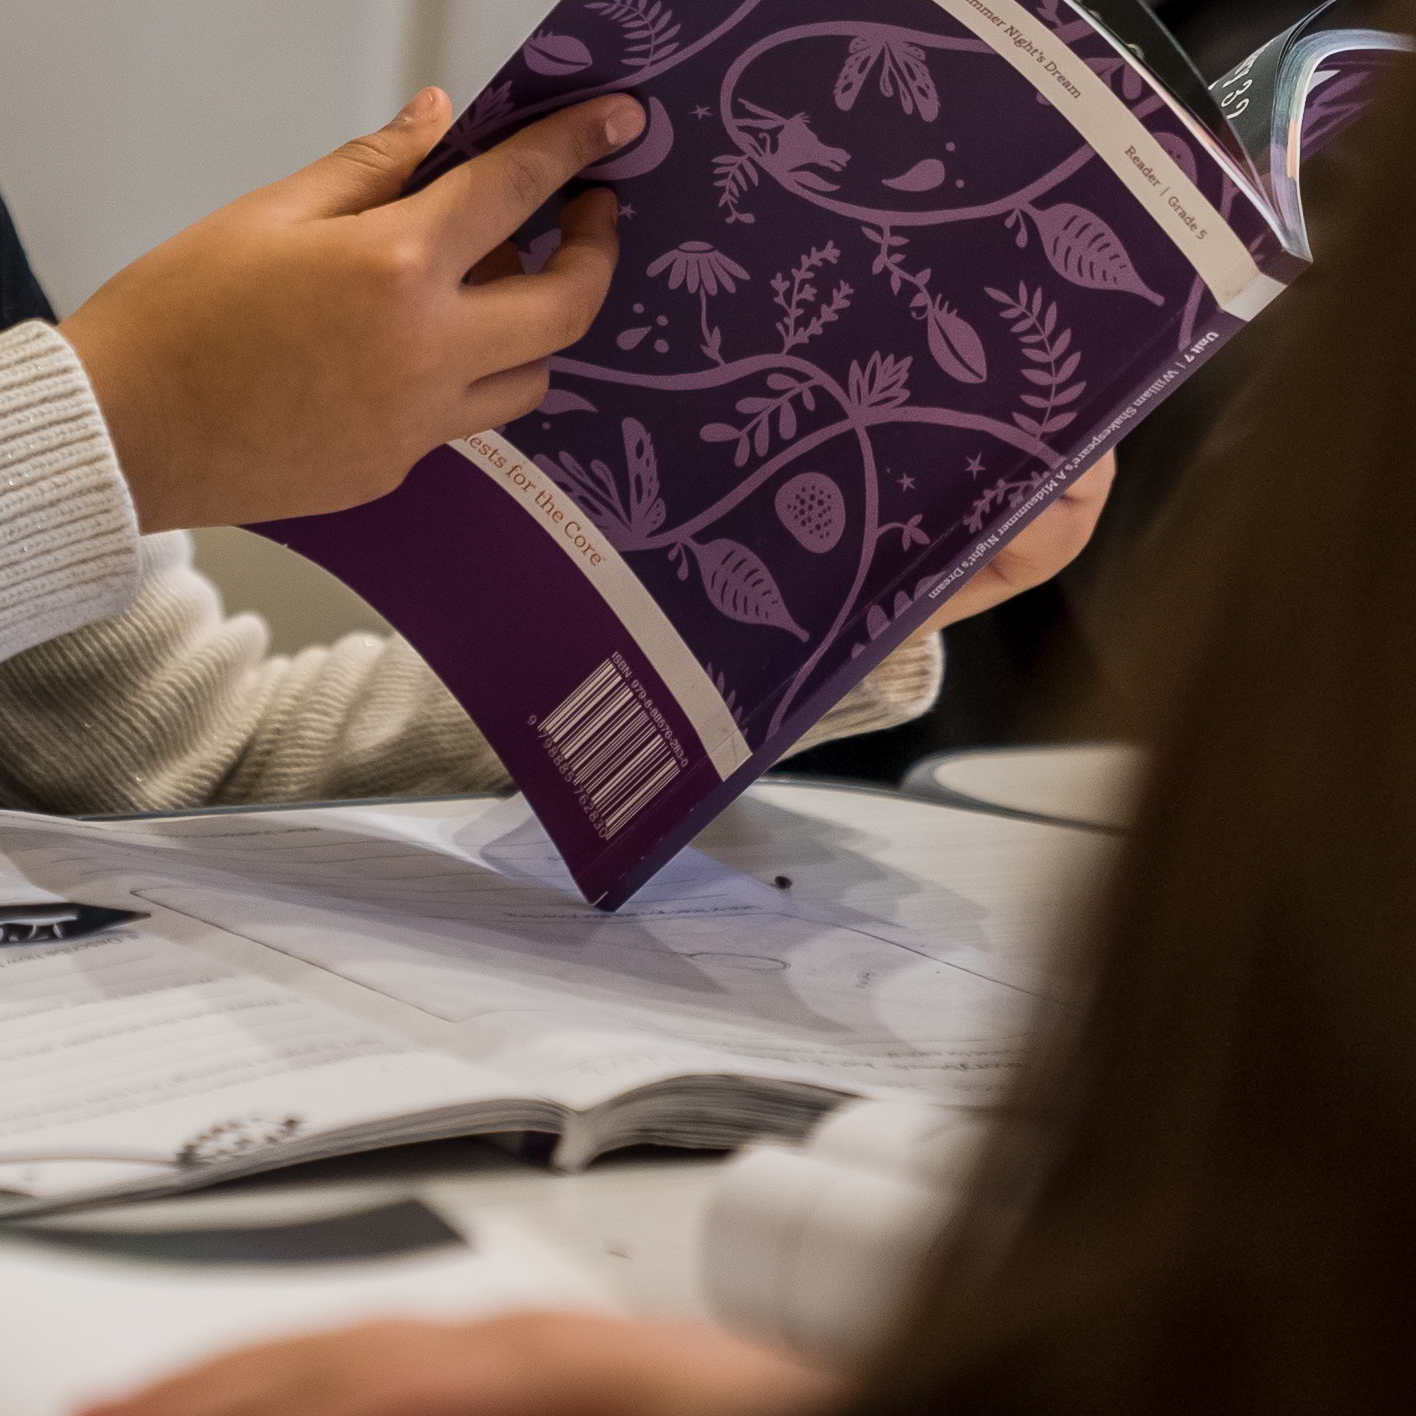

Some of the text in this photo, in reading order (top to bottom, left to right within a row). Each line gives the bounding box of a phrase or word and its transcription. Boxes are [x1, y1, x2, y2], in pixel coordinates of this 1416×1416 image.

[1003, 25, 1047, 64] Night's
[1043, 60, 1082, 100] Dream
[1124, 144, 1161, 188] Reader
[1167, 197, 1198, 233] Grade
[1196, 230, 1208, 240] 5
[1184, 353, 1195, 363] 7
[1190, 331, 1220, 356] Unit
[1132, 370, 1180, 409] William
[1064, 405, 1138, 474] Shakespeare's
[1055, 470, 1065, 480] A
[505, 464, 537, 493] for
[534, 489, 564, 524] the
[564, 520, 602, 567] Core
[997, 478, 1059, 537] Midsummer
[960, 533, 1000, 569] Night's
[928, 567, 965, 600] Dream
[630, 679, 689, 768] 979-8-88576-283-0
[526, 714, 538, 727] 9
[574, 784, 610, 839] 762830
